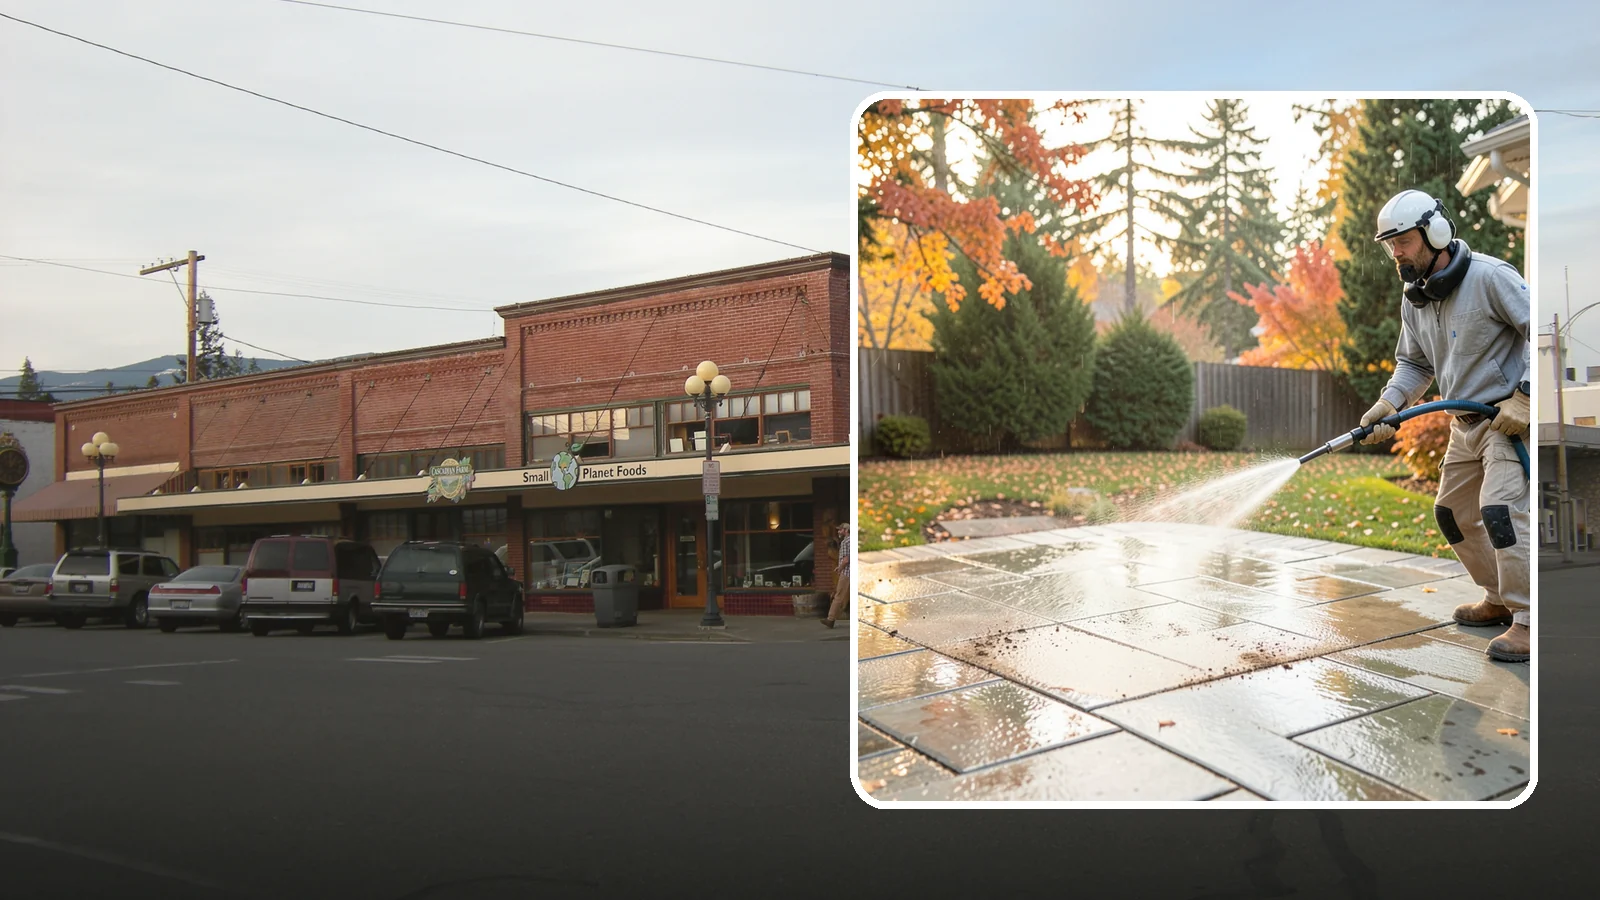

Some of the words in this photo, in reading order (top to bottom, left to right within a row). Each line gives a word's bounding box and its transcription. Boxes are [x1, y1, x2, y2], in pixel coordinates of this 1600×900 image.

[523, 471, 549, 483] Small
[583, 467, 614, 479] Planet
[617, 464, 647, 477] Foods
